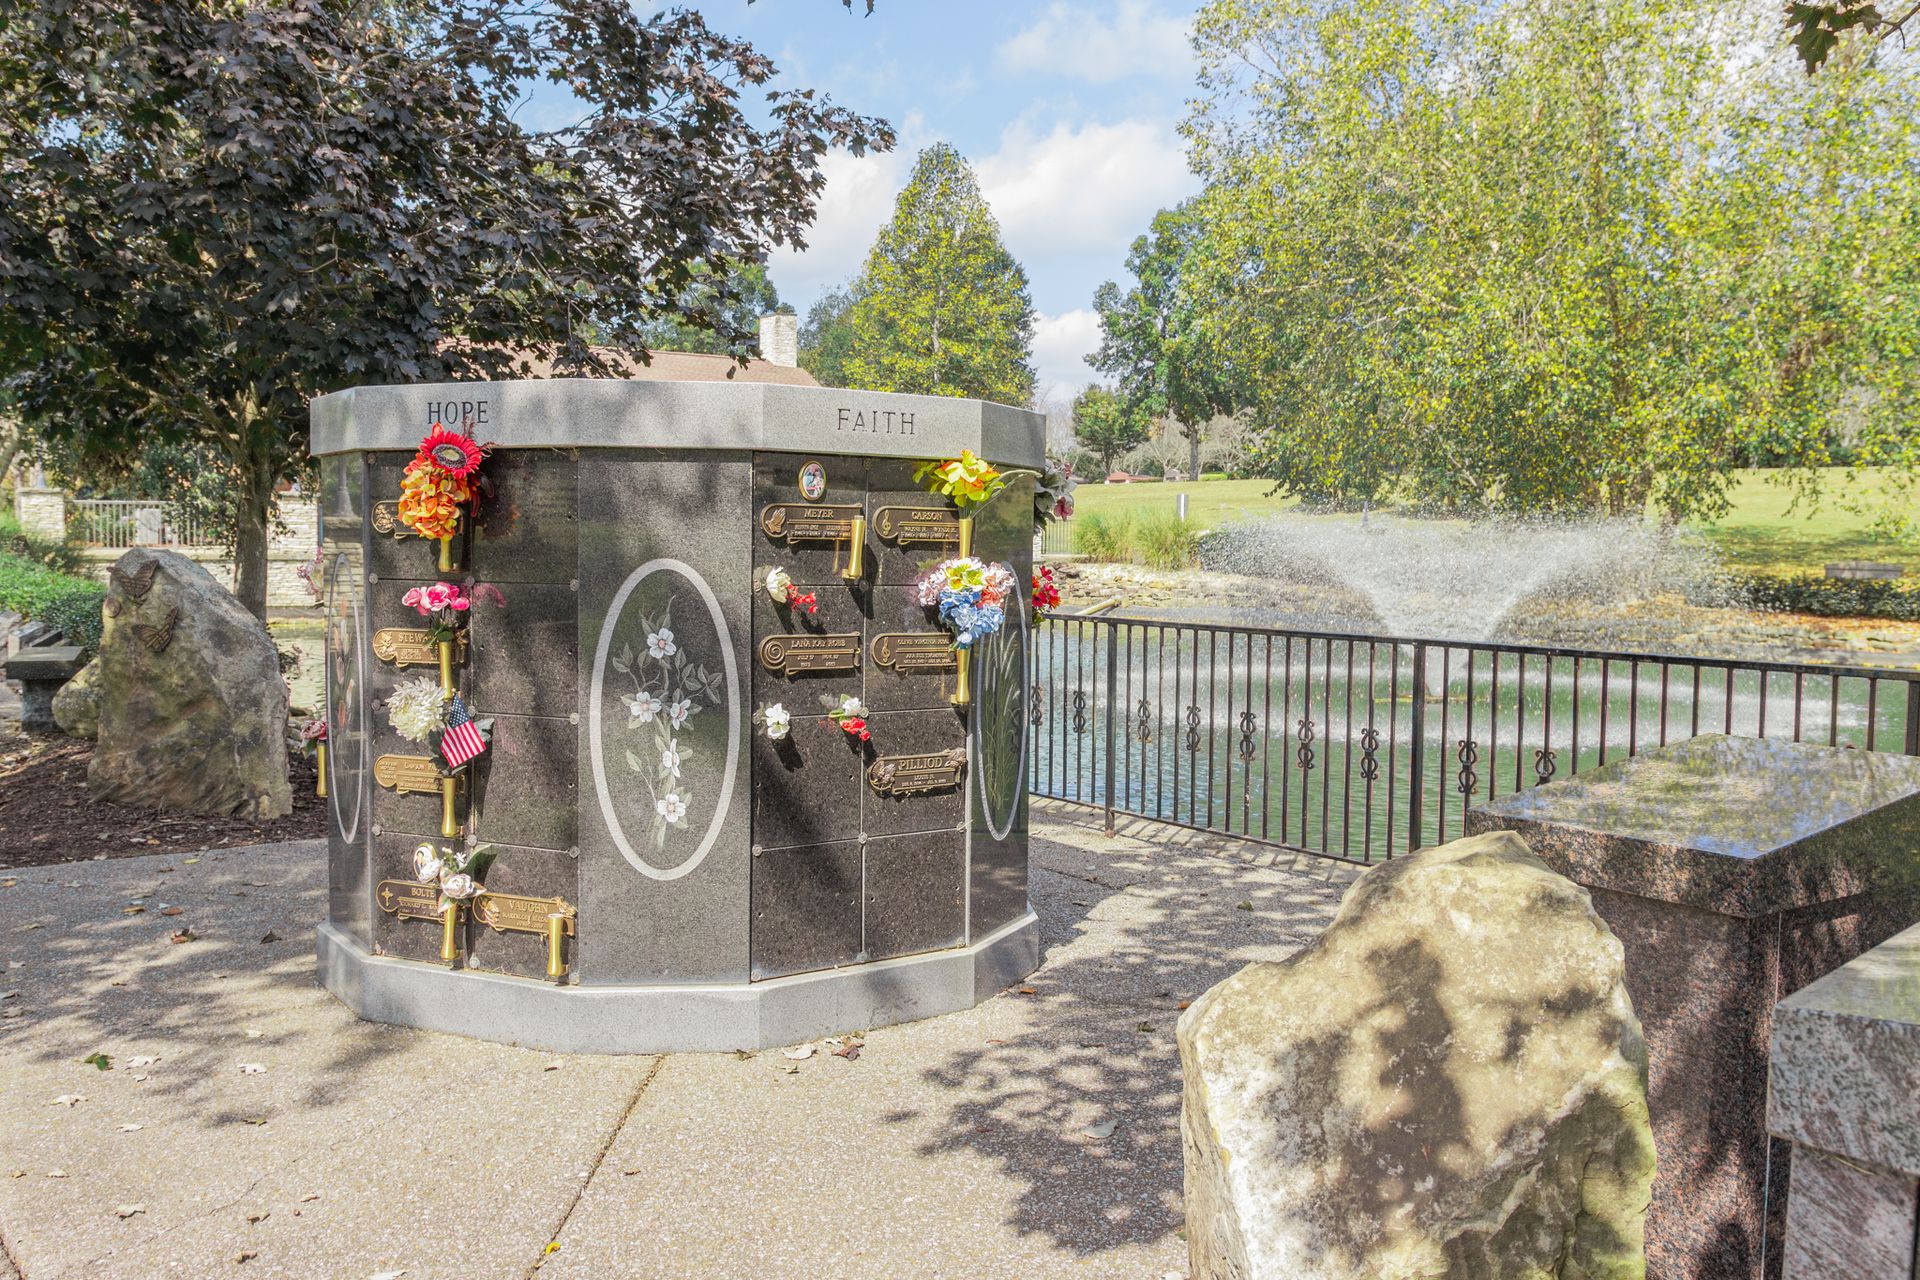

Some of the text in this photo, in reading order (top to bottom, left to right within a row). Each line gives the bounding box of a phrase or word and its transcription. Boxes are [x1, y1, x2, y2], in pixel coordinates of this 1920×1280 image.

[427, 400, 489, 425] HOPE
[837, 407, 915, 435] FAITH
[804, 508, 834, 519] MEYER
[812, 639, 827, 648] KAY
[899, 757, 943, 771] PILLIOD
[411, 887, 435, 898] BOLTE
[508, 900, 549, 914] VAUGHN
